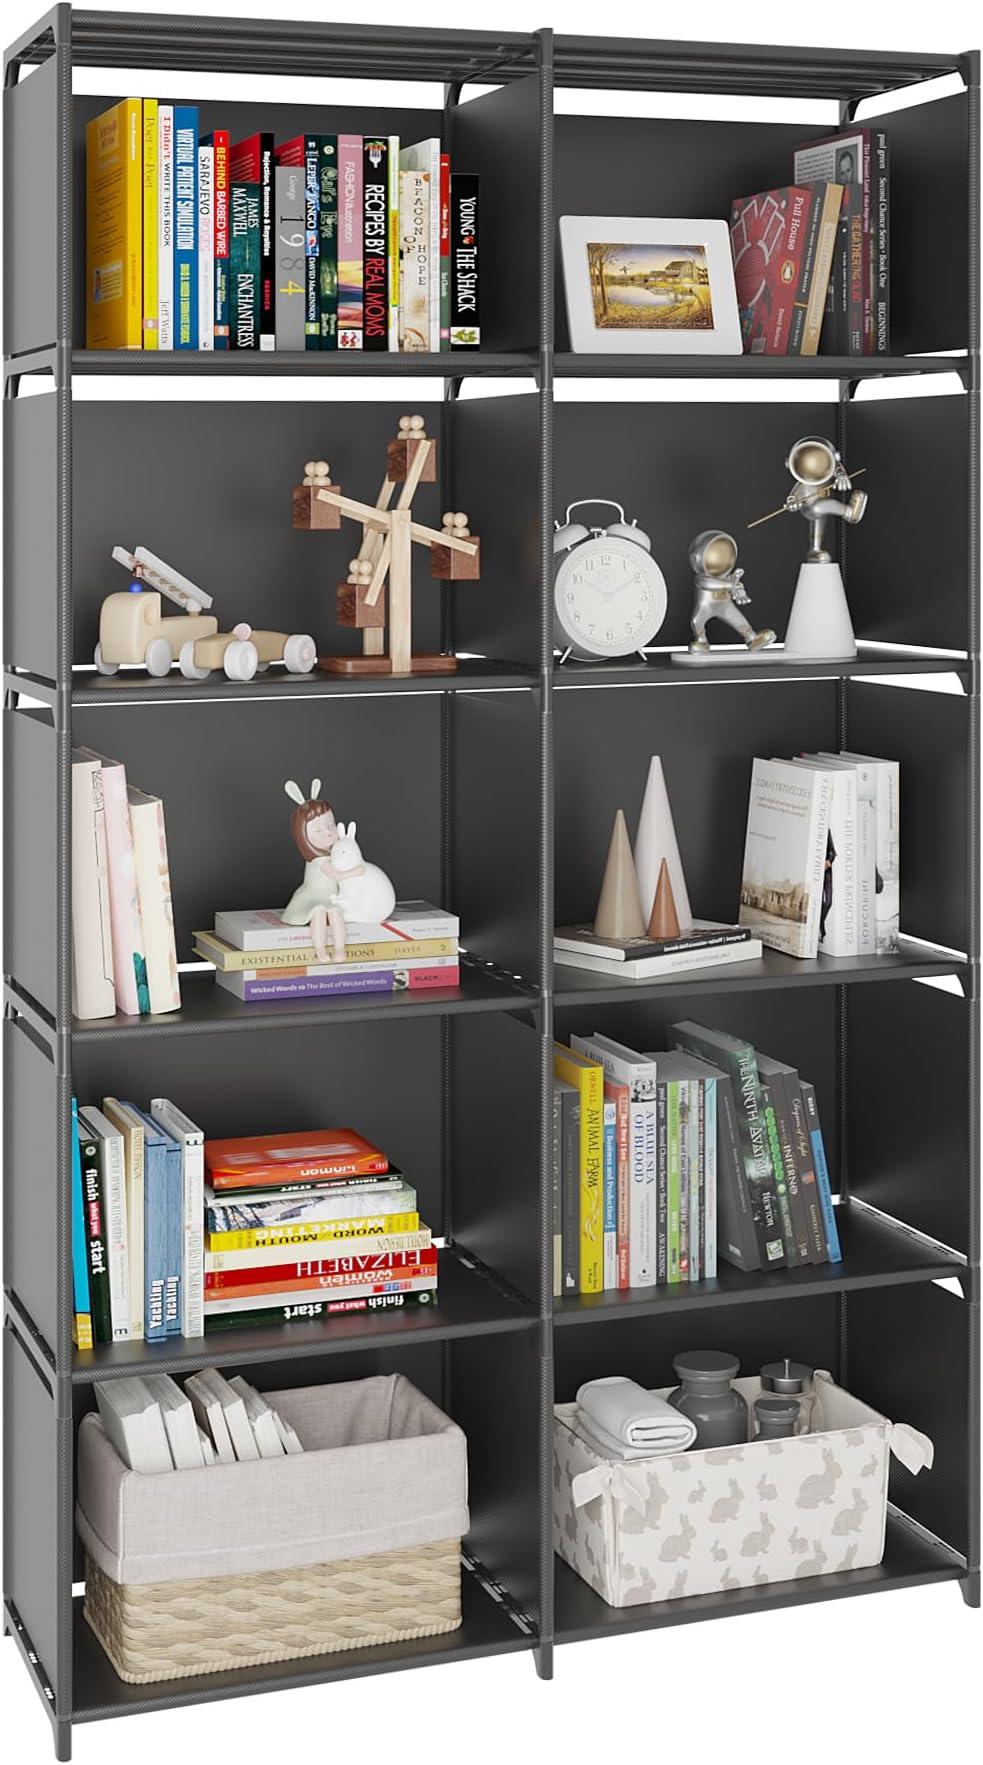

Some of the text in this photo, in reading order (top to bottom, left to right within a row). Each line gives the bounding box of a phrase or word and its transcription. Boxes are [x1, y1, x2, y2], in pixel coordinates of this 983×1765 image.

[163, 125, 171, 160] Didn't
[177, 128, 195, 164] VIRTUAL
[877, 133, 888, 169] paul green
[177, 166, 195, 200] PATIENT
[216, 147, 226, 190] BEHIND
[306, 158, 318, 191] LEPER
[344, 161, 356, 202] FASHION
[200, 156, 211, 216] SARAJEVO
[263, 186, 271, 217] Romance
[177, 201, 195, 250] SIMULATION
[216, 191, 226, 230] BARBED
[232, 188, 248, 238] MAXWELL
[245, 198, 259, 229] JAMES
[787, 196, 805, 251] Full House
[216, 231, 226, 256] WIRE
[879, 177, 888, 288] Second Chance Series Book One
[308, 257, 316, 279] DAVID
[365, 184, 385, 336] RECIPES BY REAL MOMS
[456, 196, 478, 312] YOUNG THE SHACK
[237, 273, 254, 347] ENCHANTRESS
[878, 302, 887, 350] BEGINNINGS
[160, 319, 170, 344] Watts
[584, 559, 594, 571] 11
[600, 554, 611, 567] 12
[571, 573, 583, 585] 10
[633, 572, 641, 584] 2
[566, 592, 574, 605] 9
[640, 591, 649, 602] 3
[574, 609, 582, 623] 8
[586, 624, 597, 636] 7
[241, 953, 308, 967] EXISTENTIAL
[250, 984, 276, 994] Wicked
[307, 980, 319, 990] The
[741, 1074, 760, 1122] NINTH
[634, 1114, 645, 1133] OF
[586, 1109, 601, 1189] ANIMAL FARM
[634, 1135, 645, 1183] BLOOD
[645, 1111, 655, 1185] A BLUE SEA
[85, 1168, 99, 1202] finish
[90, 1202, 99, 1221] what
[254, 1217, 386, 1238] MARKETING
[254, 1226, 385, 1246] WORD MOUTH
[90, 1240, 107, 1275] start
[295, 1249, 421, 1277] ELIZABETH
[659, 1232, 667, 1277] AWAKENING
[319, 1269, 393, 1286] women
[149, 1279, 165, 1329] Yachting
[166, 1275, 180, 1321] Yachting
[284, 1295, 405, 1319] finish what you start
